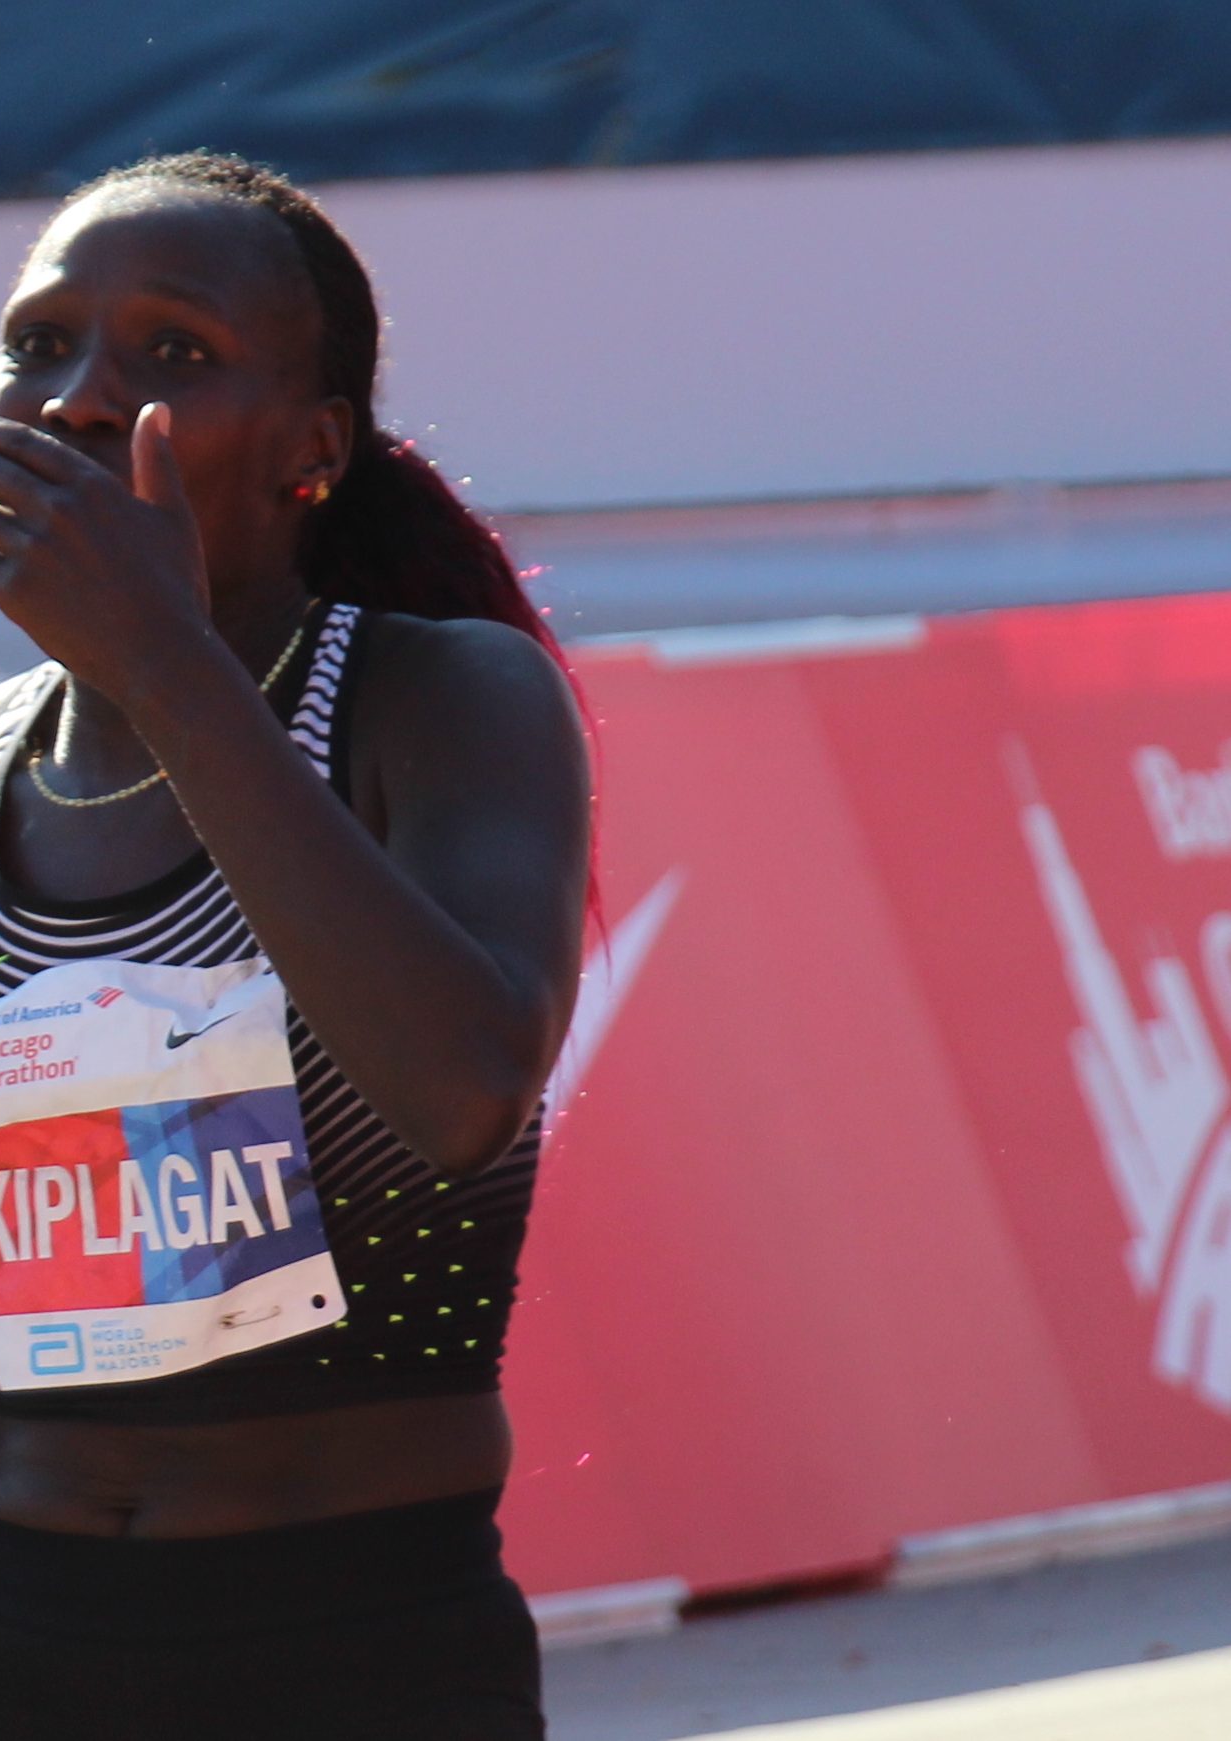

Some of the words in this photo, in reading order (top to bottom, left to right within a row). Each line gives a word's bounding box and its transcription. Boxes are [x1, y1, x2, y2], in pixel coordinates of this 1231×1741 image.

[1, 1008, 18, 1025] of
[19, 1001, 82, 1022] America
[91, 1328, 144, 1341] WORLD
[93, 1338, 188, 1357] MARATHON
[95, 1355, 162, 1371] MAJORS
